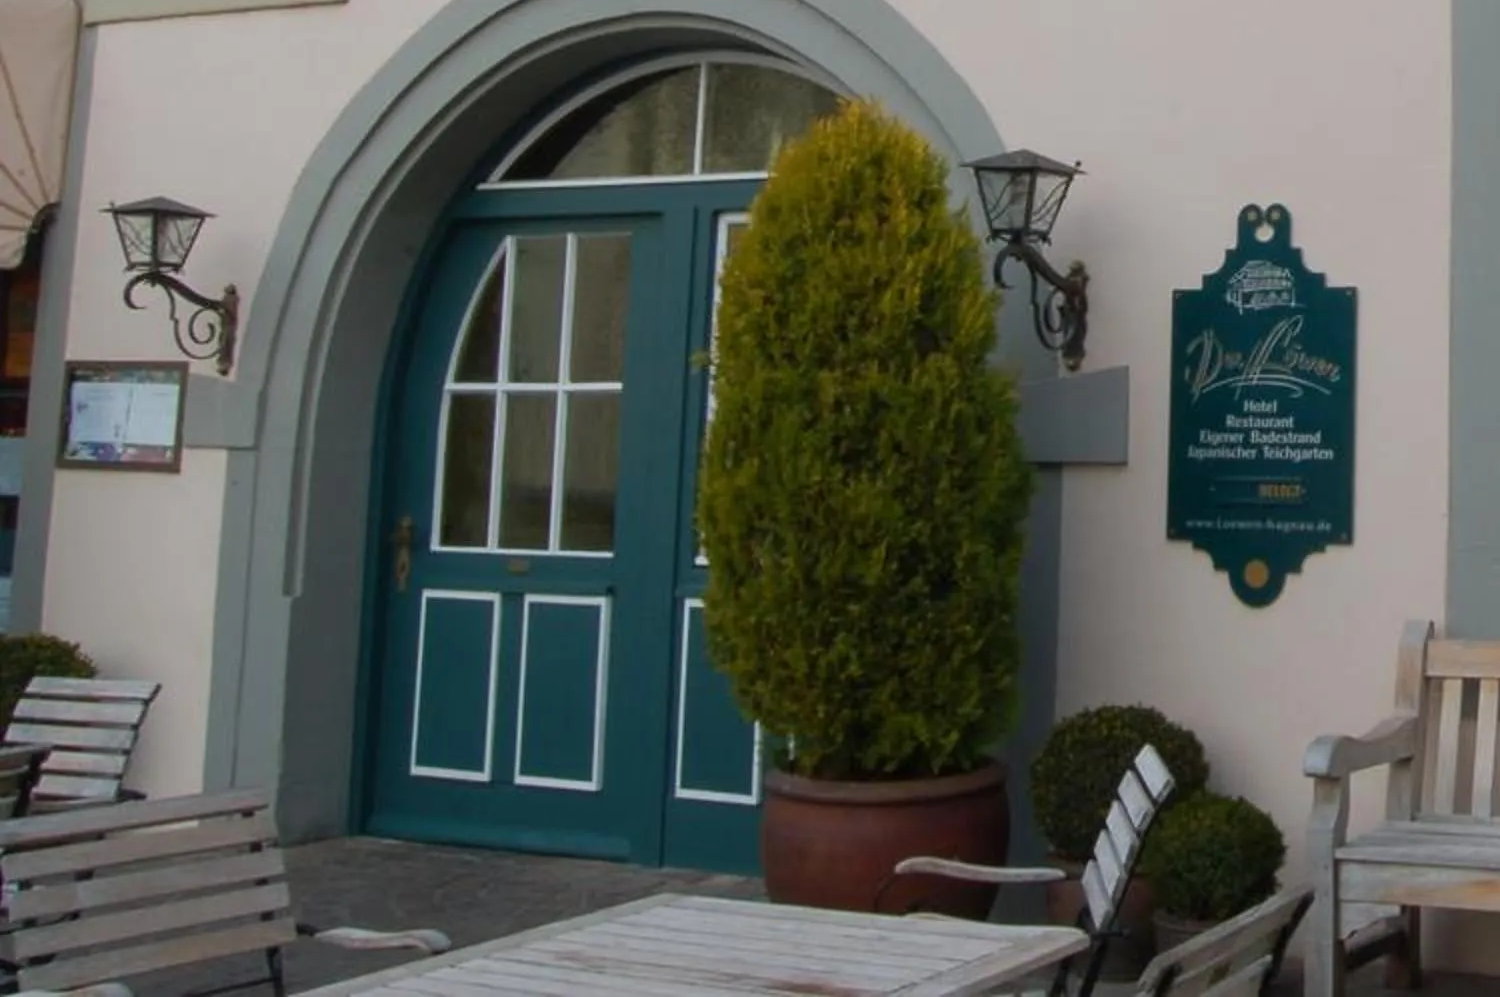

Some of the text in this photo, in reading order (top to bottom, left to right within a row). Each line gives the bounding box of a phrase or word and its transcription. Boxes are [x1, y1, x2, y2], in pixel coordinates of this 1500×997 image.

[1243, 399, 1278, 413] Hotel
[1225, 414, 1295, 429] Restaurant
[1199, 429, 1322, 446] Eigener Badestrand
[1187, 444, 1335, 464] Japanischer Teichgarten
